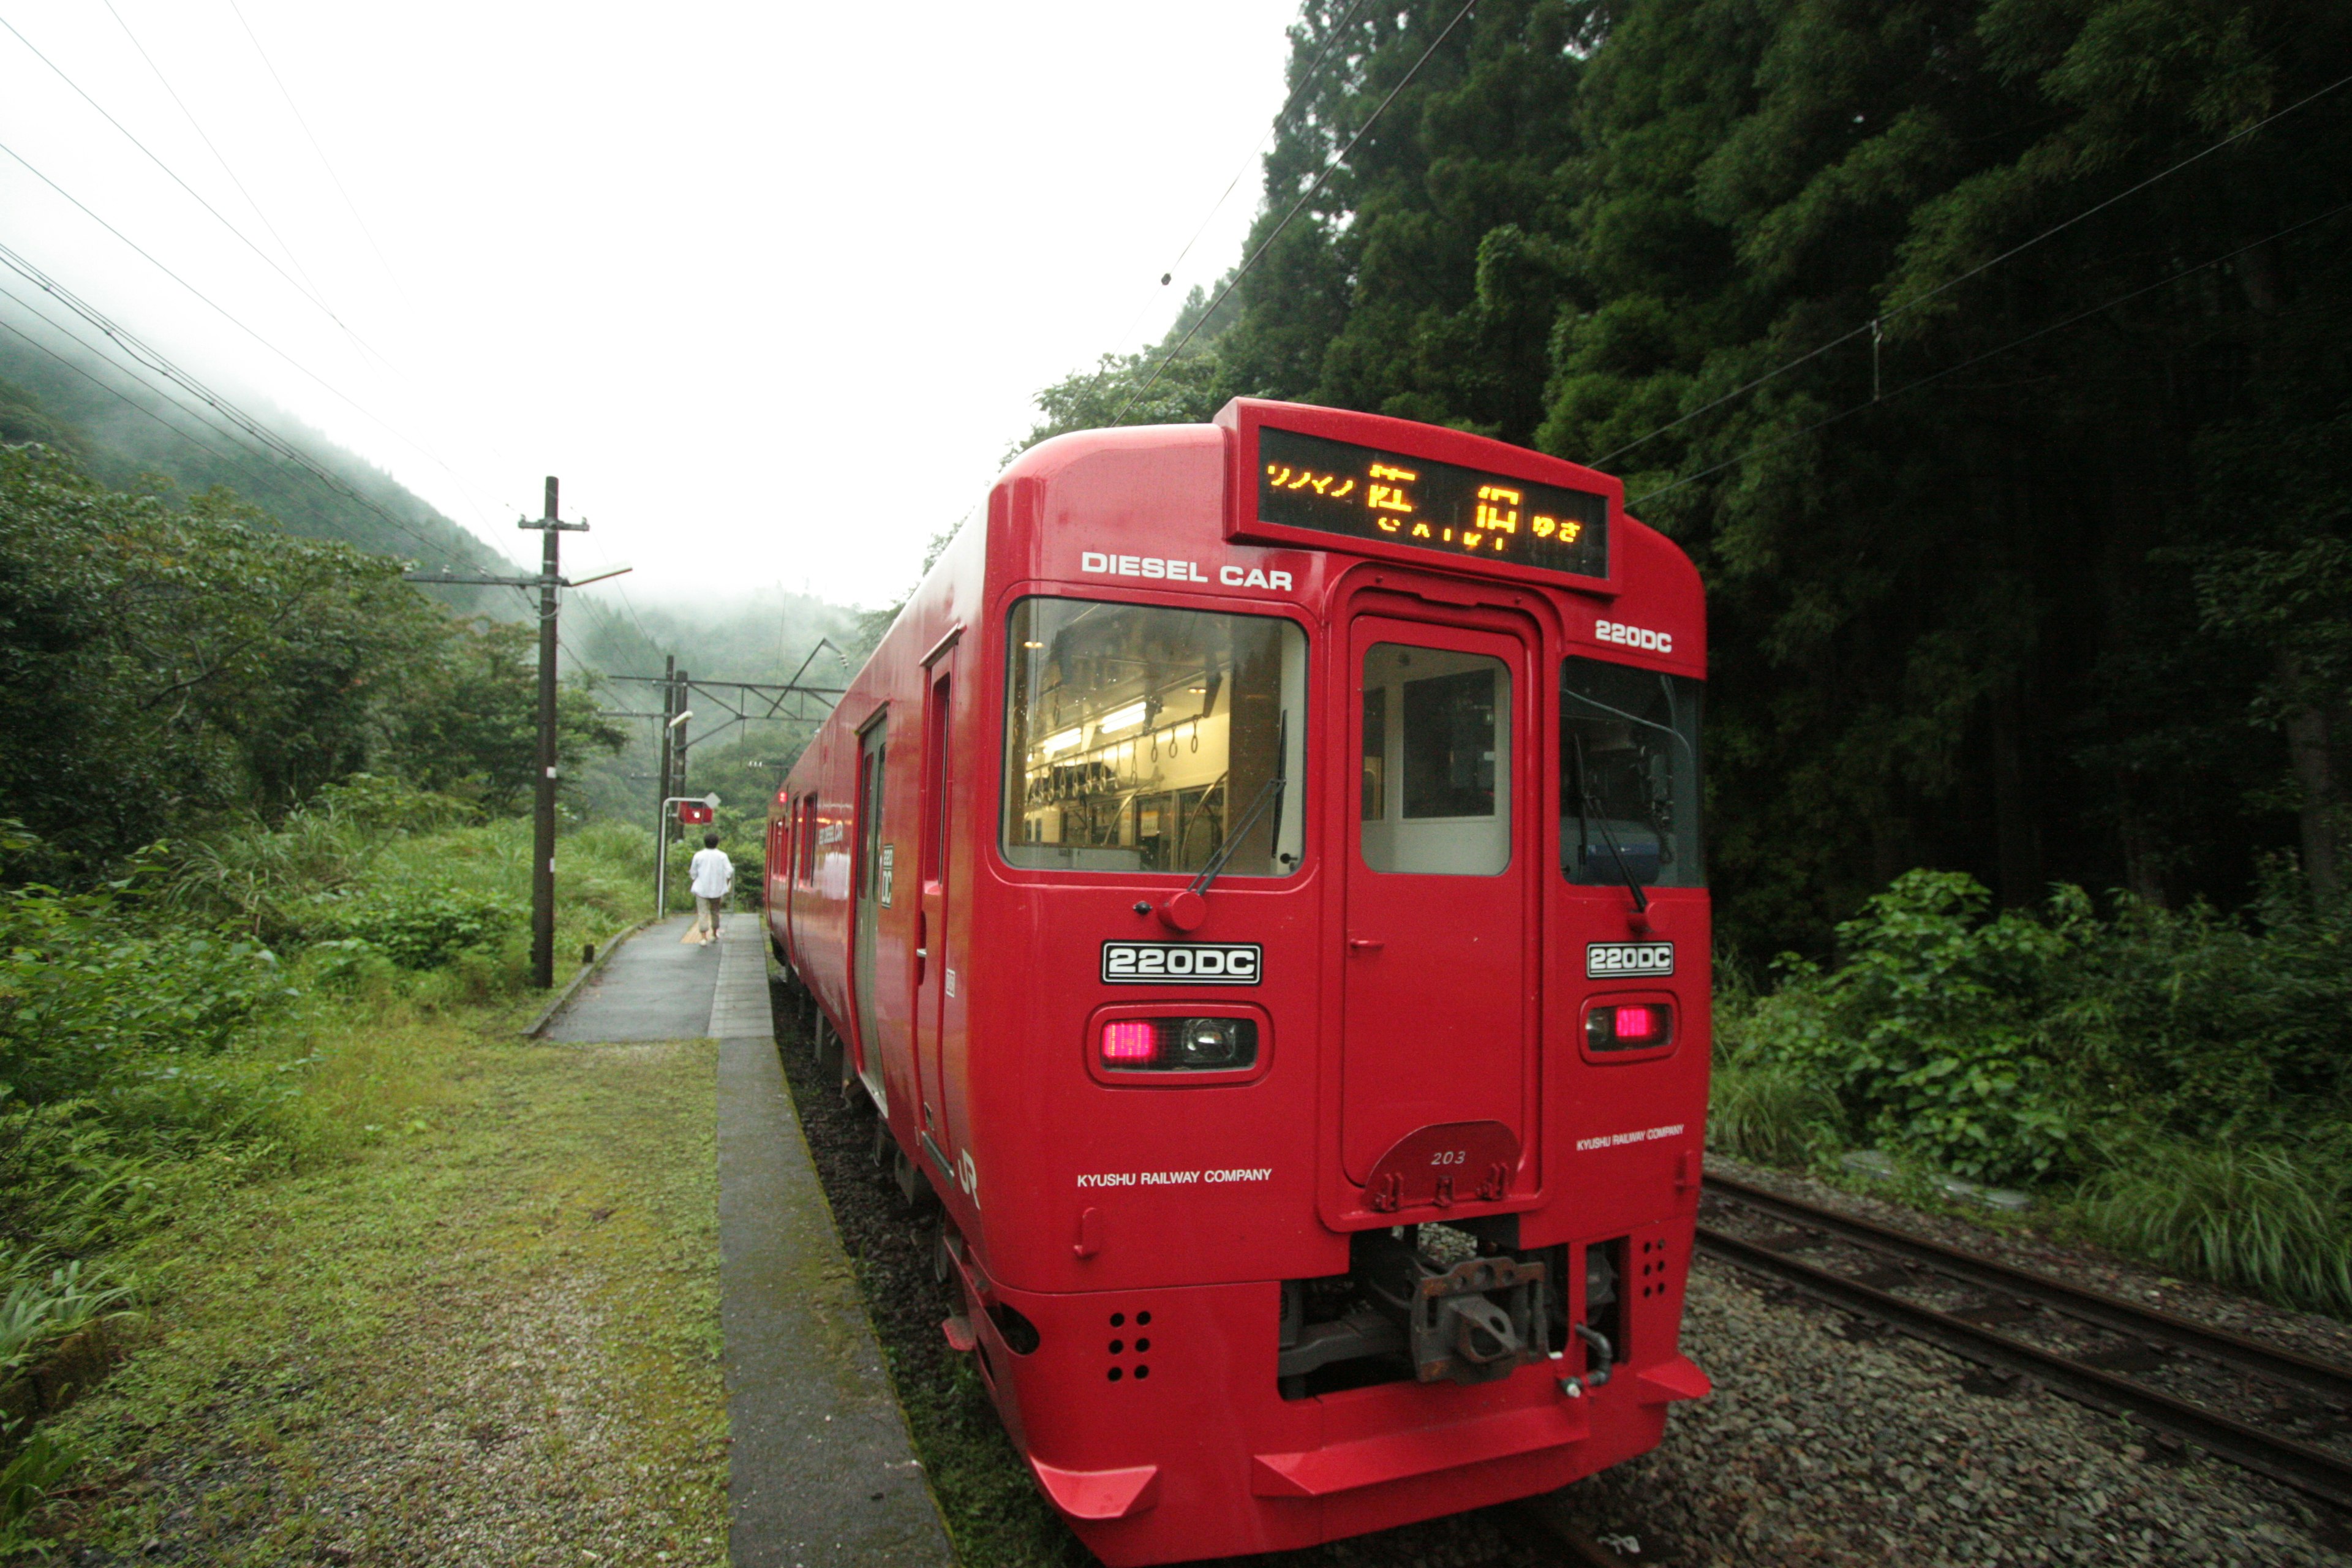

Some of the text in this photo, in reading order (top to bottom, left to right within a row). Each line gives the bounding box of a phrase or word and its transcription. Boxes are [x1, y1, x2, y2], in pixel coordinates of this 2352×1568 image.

[1082, 551, 1292, 591] DIESEL CAR
[1595, 619, 1672, 654] 220DC
[883, 848, 893, 867] 220
[881, 870, 892, 904] DC
[1109, 948, 1255, 974] 220DC
[1590, 946, 1671, 970] 220DC
[1576, 1123, 1684, 1152] KYUSHU RAILWAY COMPANY
[1431, 1150, 1466, 1165] 203
[958, 1147, 981, 1211] JR
[1077, 1168, 1272, 1187] KYUSHU RAILWAY COMPANY
